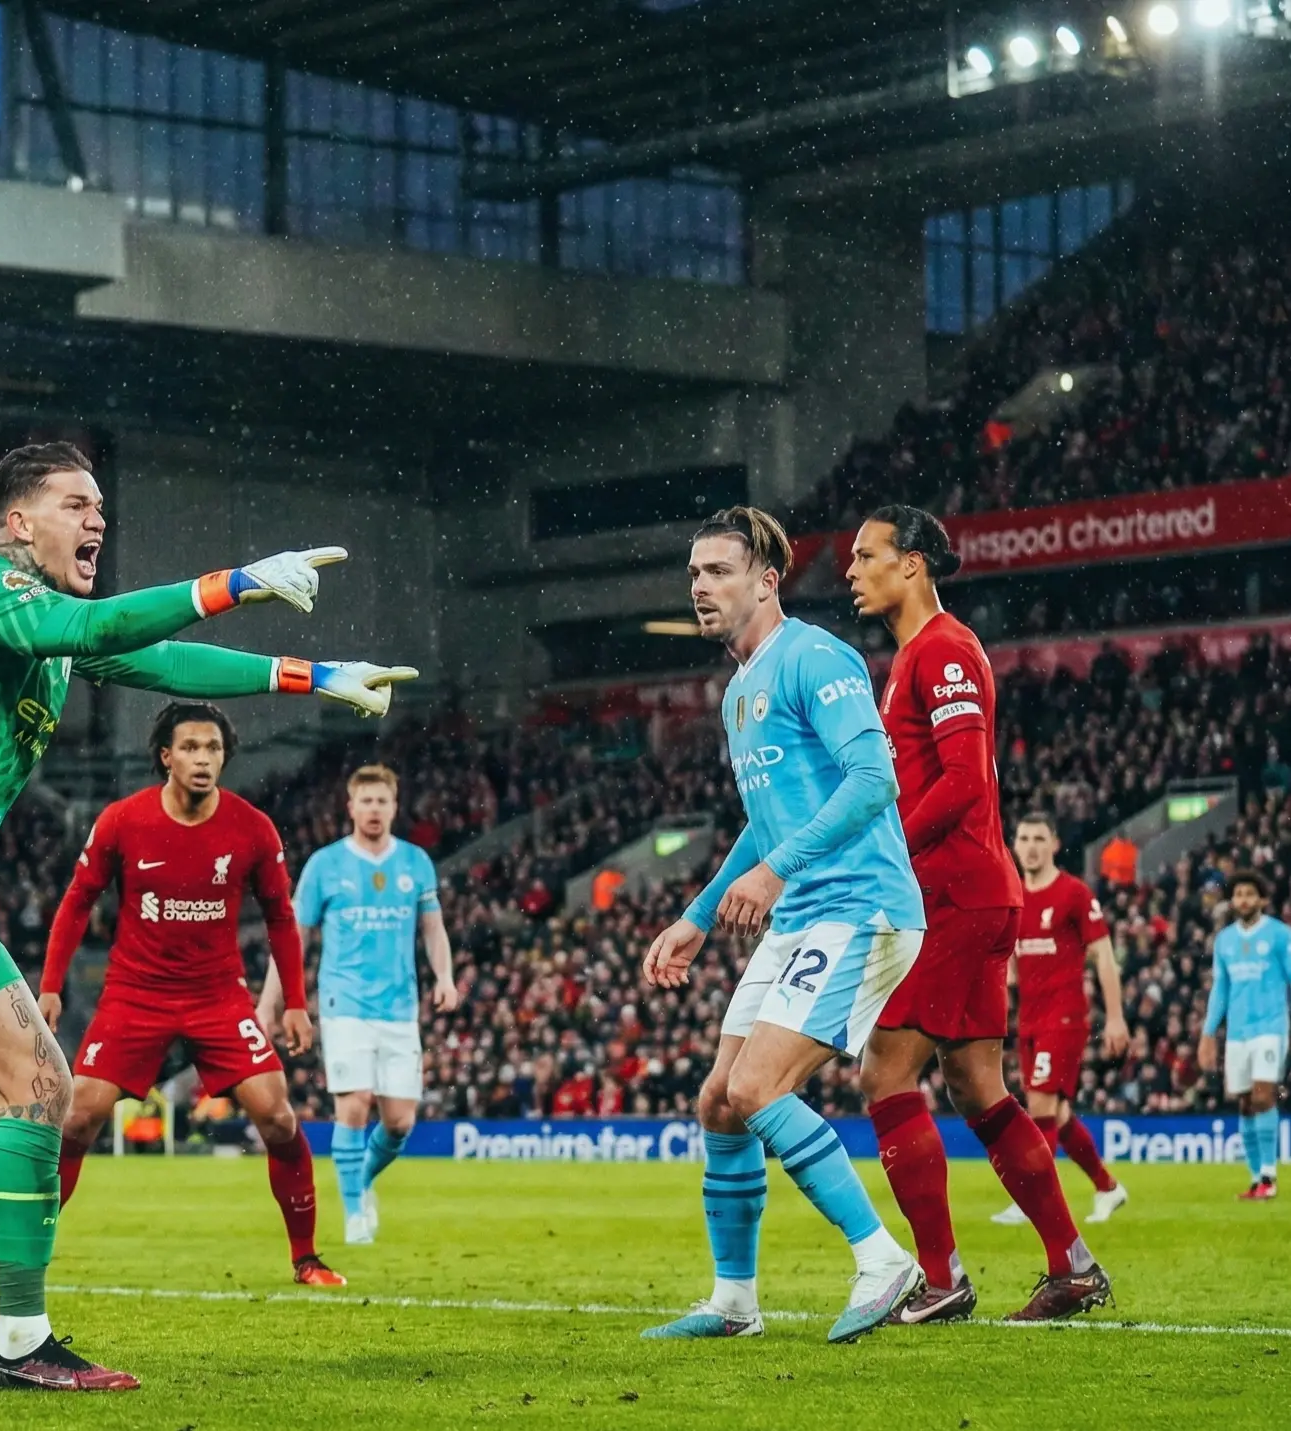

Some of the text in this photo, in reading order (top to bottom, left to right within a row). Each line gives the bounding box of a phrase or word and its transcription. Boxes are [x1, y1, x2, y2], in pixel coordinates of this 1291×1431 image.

[1068, 497, 1216, 551] chartered
[778, 947, 828, 994] 12
[238, 1018, 267, 1051] 9
[1034, 1051, 1052, 1080] 5
